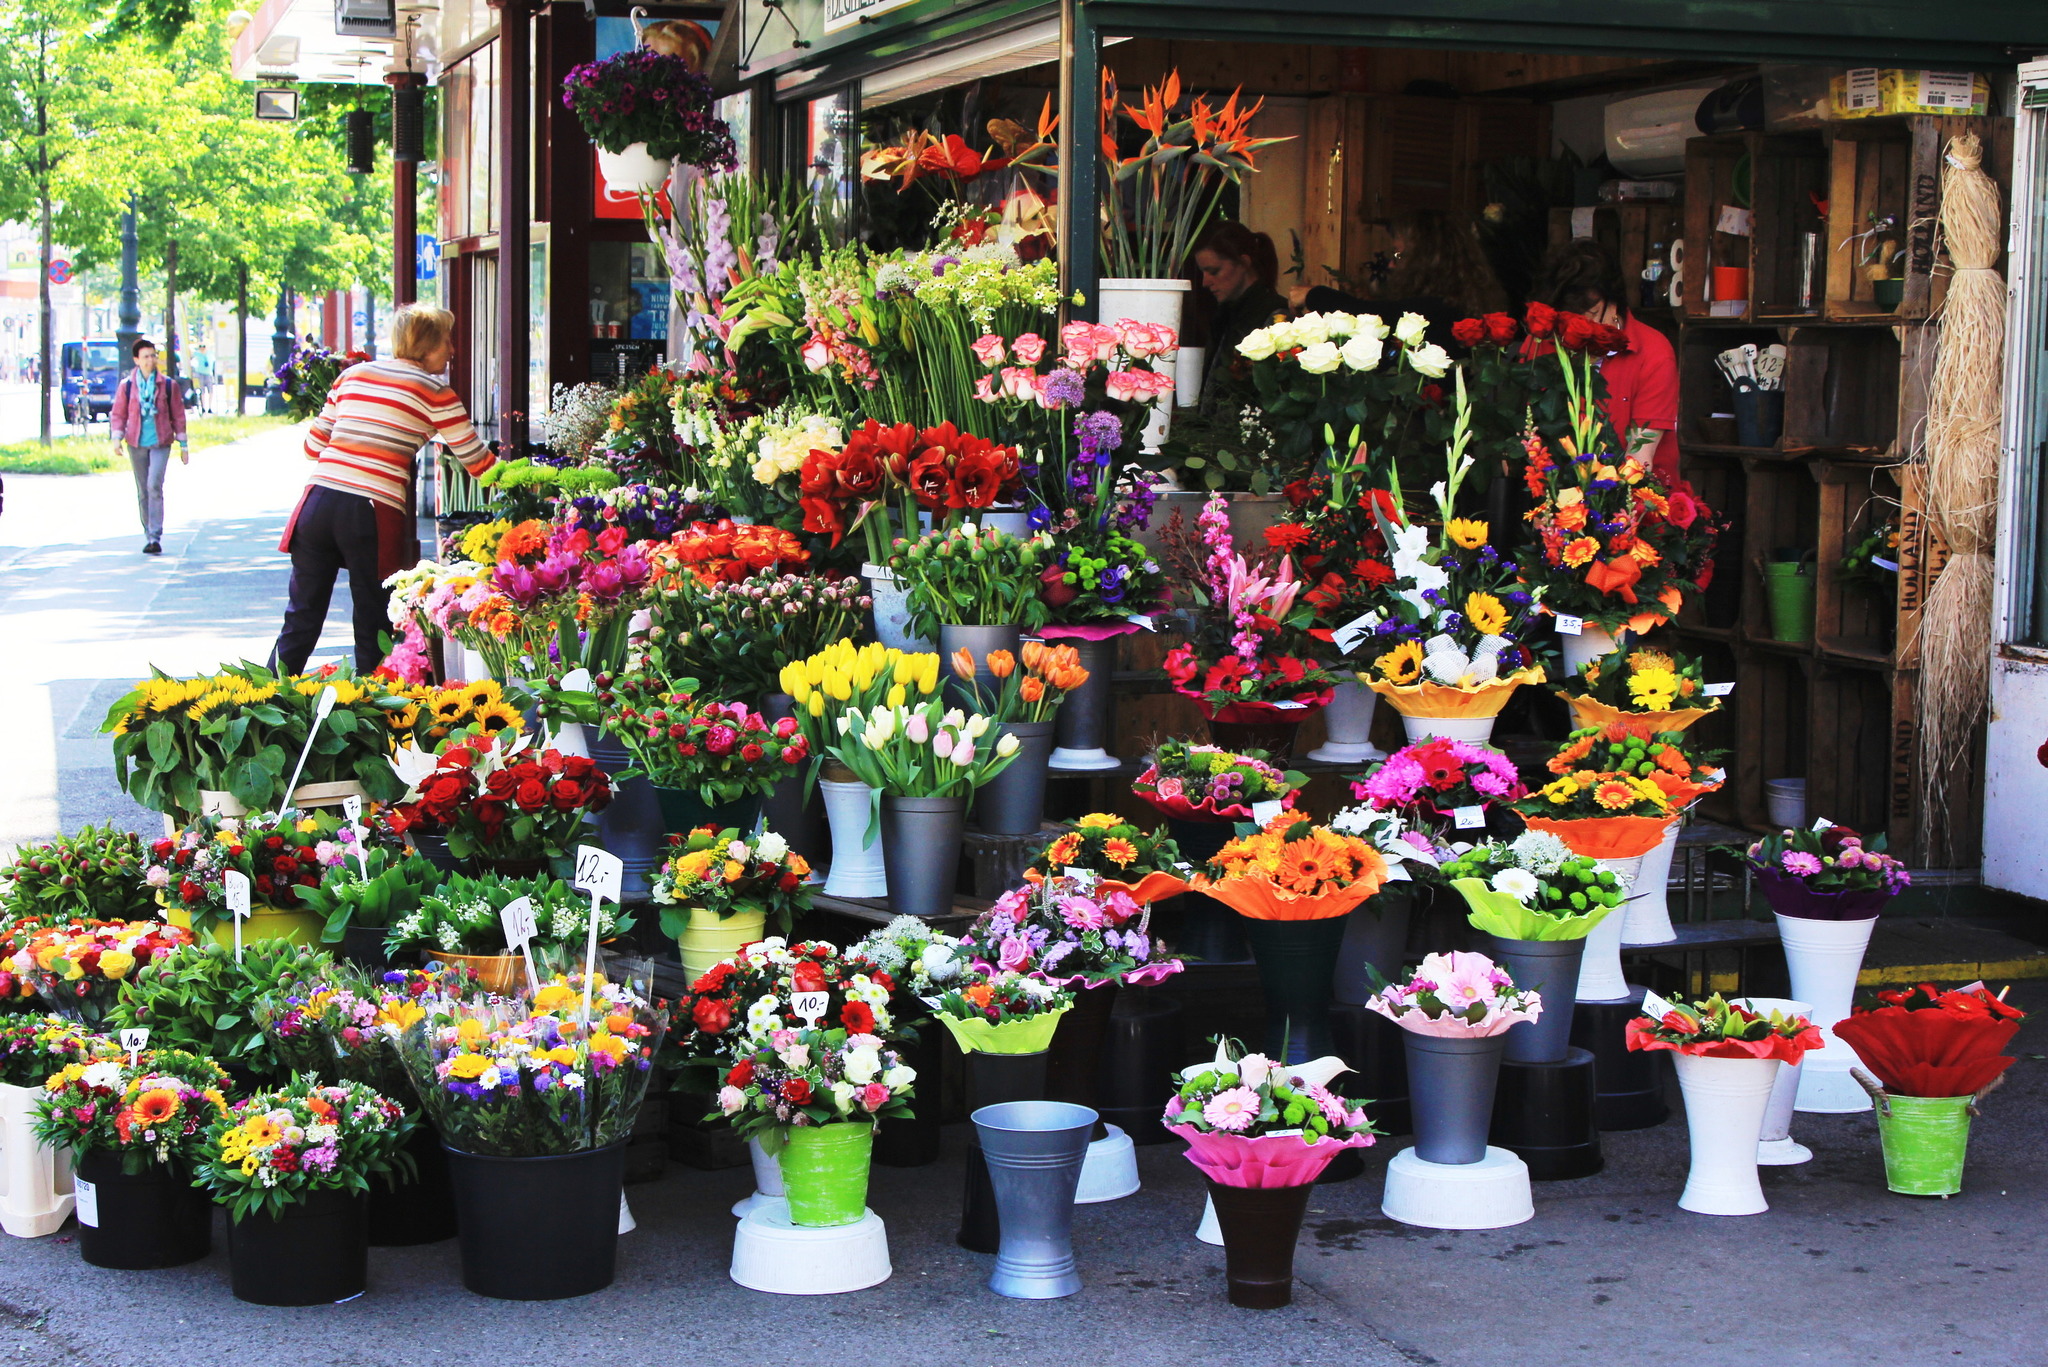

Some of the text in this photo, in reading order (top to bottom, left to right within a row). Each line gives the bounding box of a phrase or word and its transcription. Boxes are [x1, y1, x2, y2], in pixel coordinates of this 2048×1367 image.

[1901, 511, 1919, 611] HOLLAND
[1893, 720, 1913, 818] HOLLAND
[798, 996, 825, 1012] 10.-
[126, 1032, 145, 1048] 10.-
